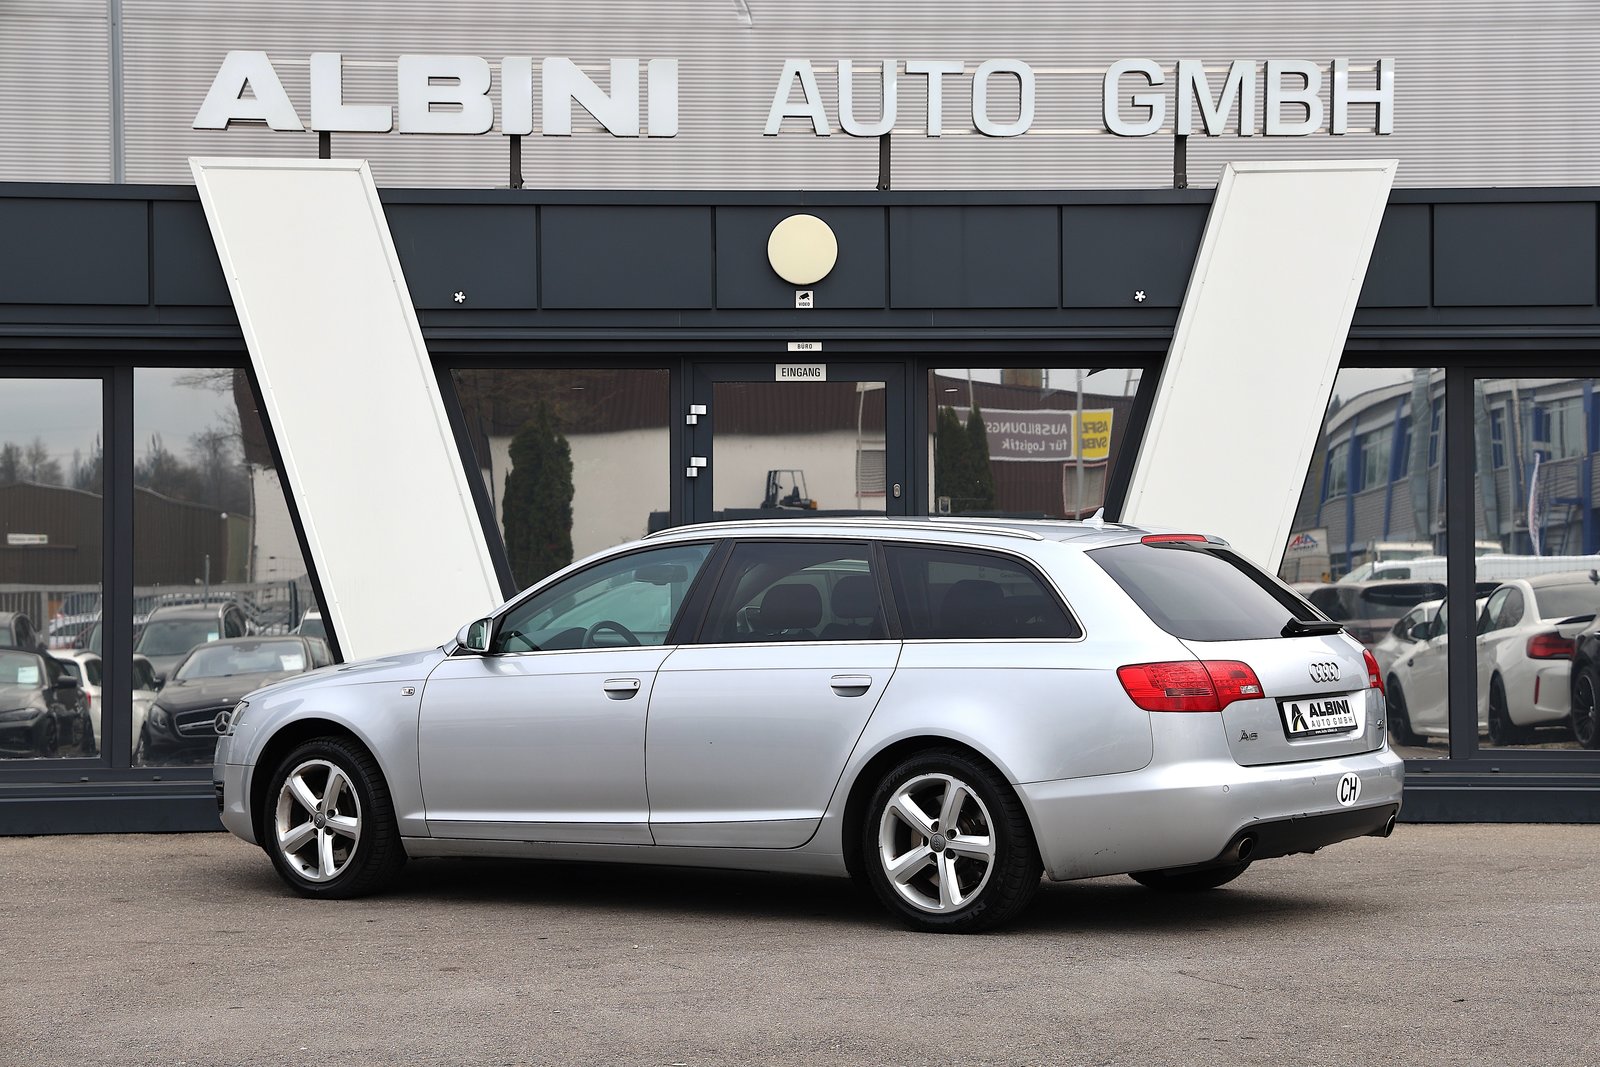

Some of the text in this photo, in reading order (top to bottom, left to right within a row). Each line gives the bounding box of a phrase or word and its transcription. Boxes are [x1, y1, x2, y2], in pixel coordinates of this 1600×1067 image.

[192, 50, 1396, 137] ALBINI AUTO GMBH
[781, 367, 821, 377] EINGANG
[1309, 699, 1351, 717] ALBINI
[1311, 716, 1354, 728] AUTO GMBH
[1340, 776, 1357, 802] CH
